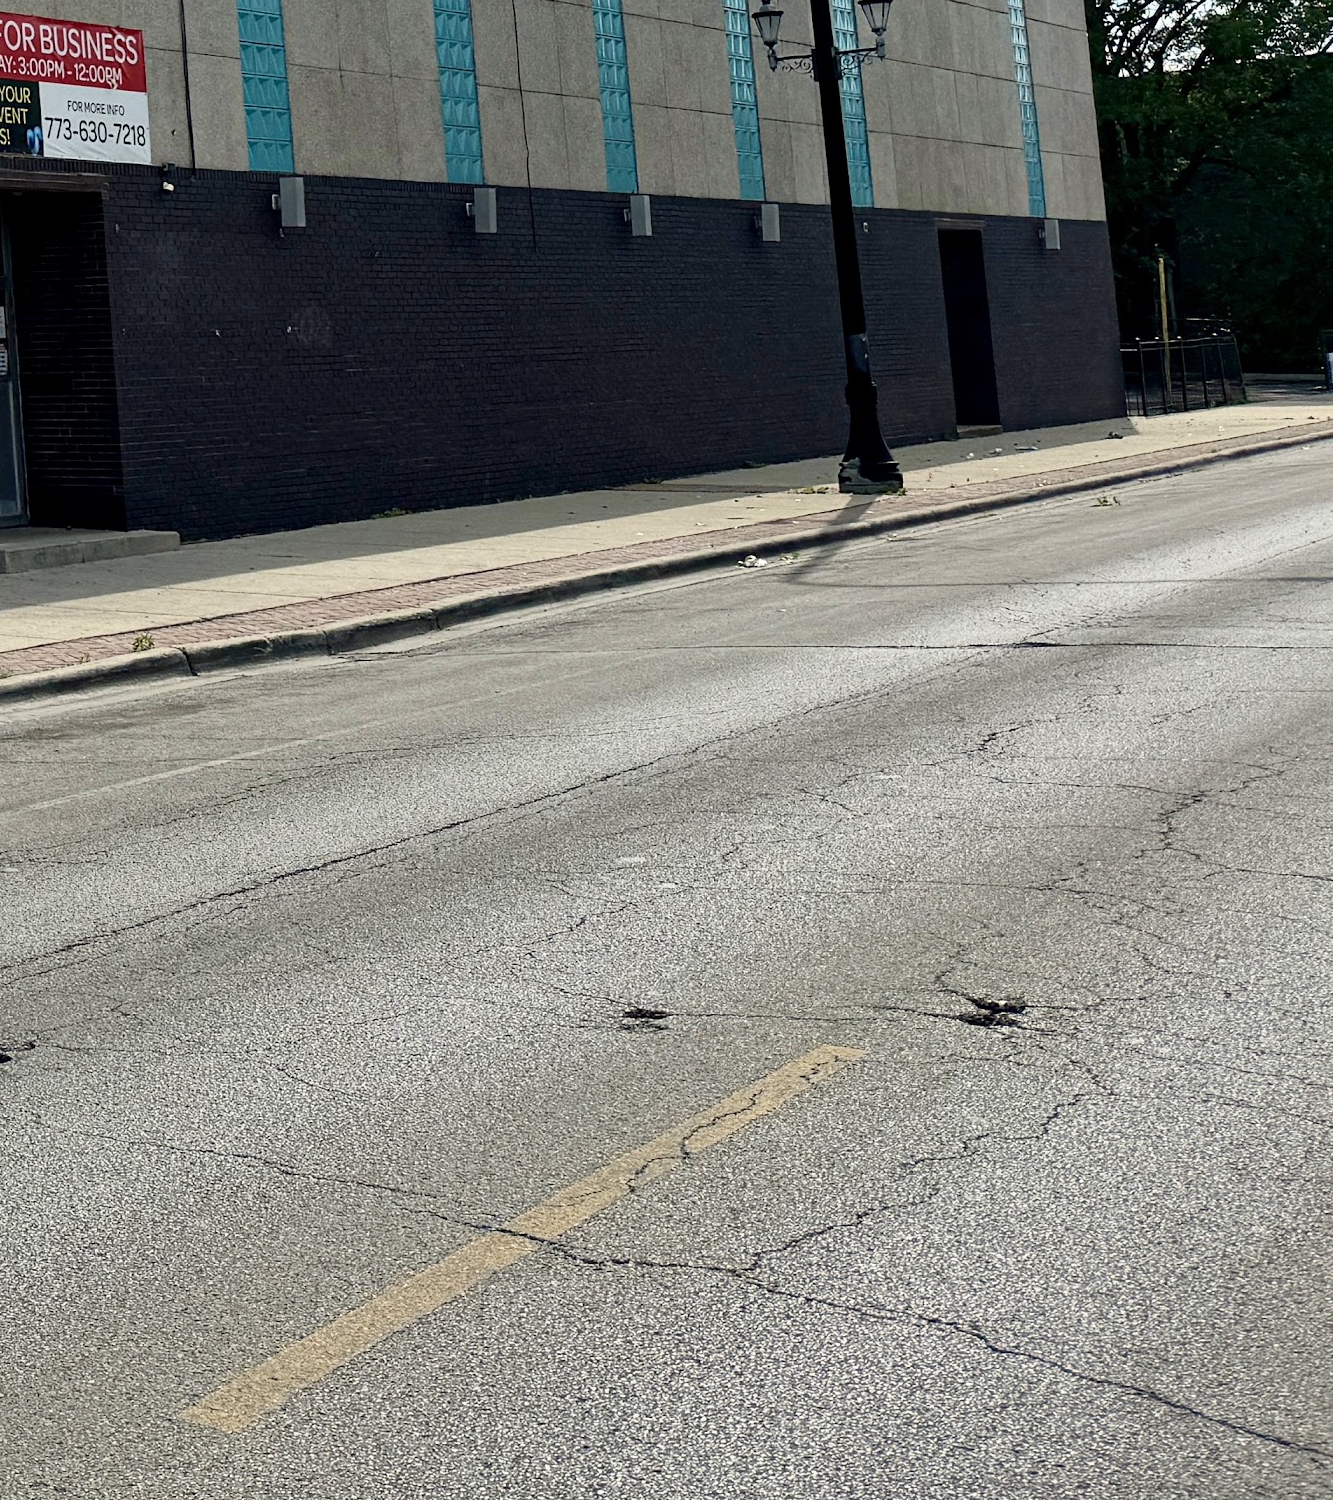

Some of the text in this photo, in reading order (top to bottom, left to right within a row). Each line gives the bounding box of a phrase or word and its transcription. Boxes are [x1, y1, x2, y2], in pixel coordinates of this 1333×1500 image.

[39, 24, 139, 65] BUSINESS
[17, 56, 65, 79] 3:00PM
[67, 100, 125, 116] FOR MORE INFO
[44, 116, 146, 147] 773-630-7218
